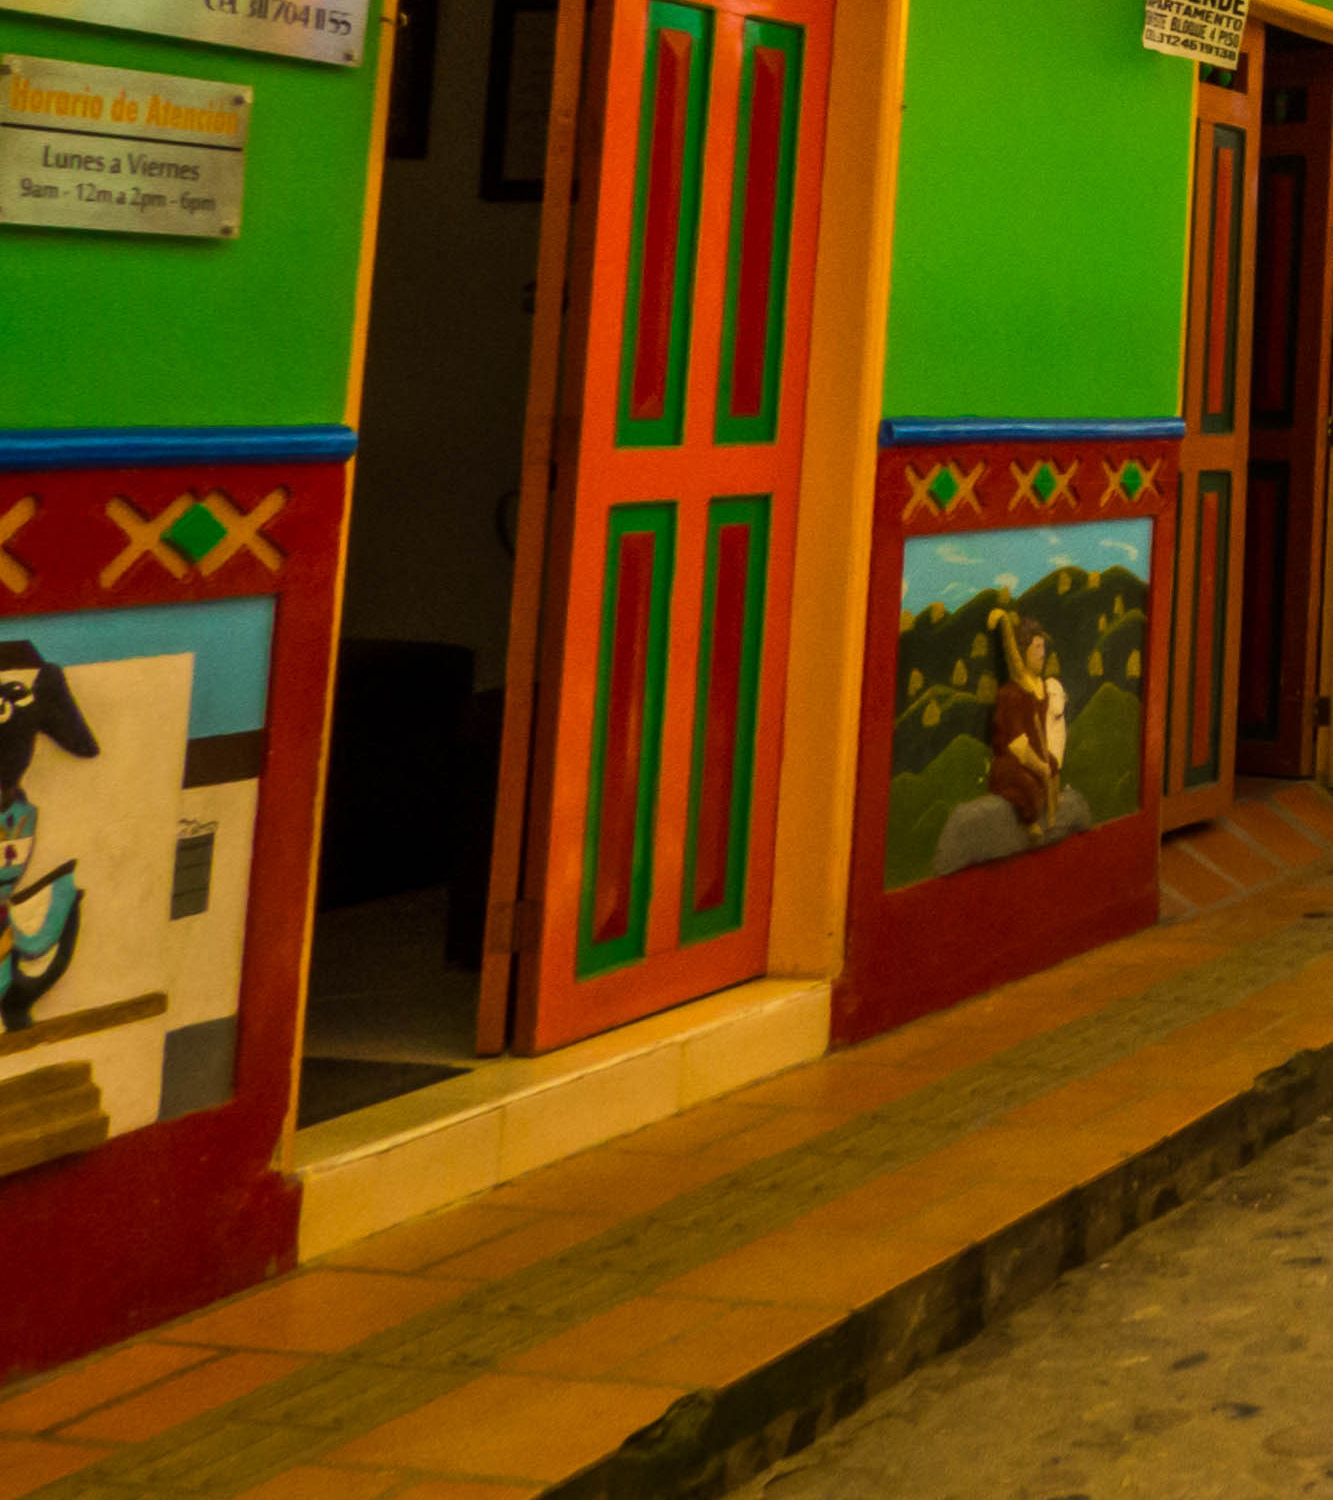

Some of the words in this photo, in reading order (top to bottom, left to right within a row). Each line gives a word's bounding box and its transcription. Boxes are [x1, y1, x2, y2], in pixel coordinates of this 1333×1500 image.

[9, 75, 103, 121] Horario
[110, 86, 139, 123] de
[41, 143, 105, 174] Lunes
[108, 156, 122, 175] a
[127, 152, 201, 182] Viernes
[19, 177, 59, 199] 9am
[115, 190, 127, 205] a
[130, 187, 167, 213] 2pm
